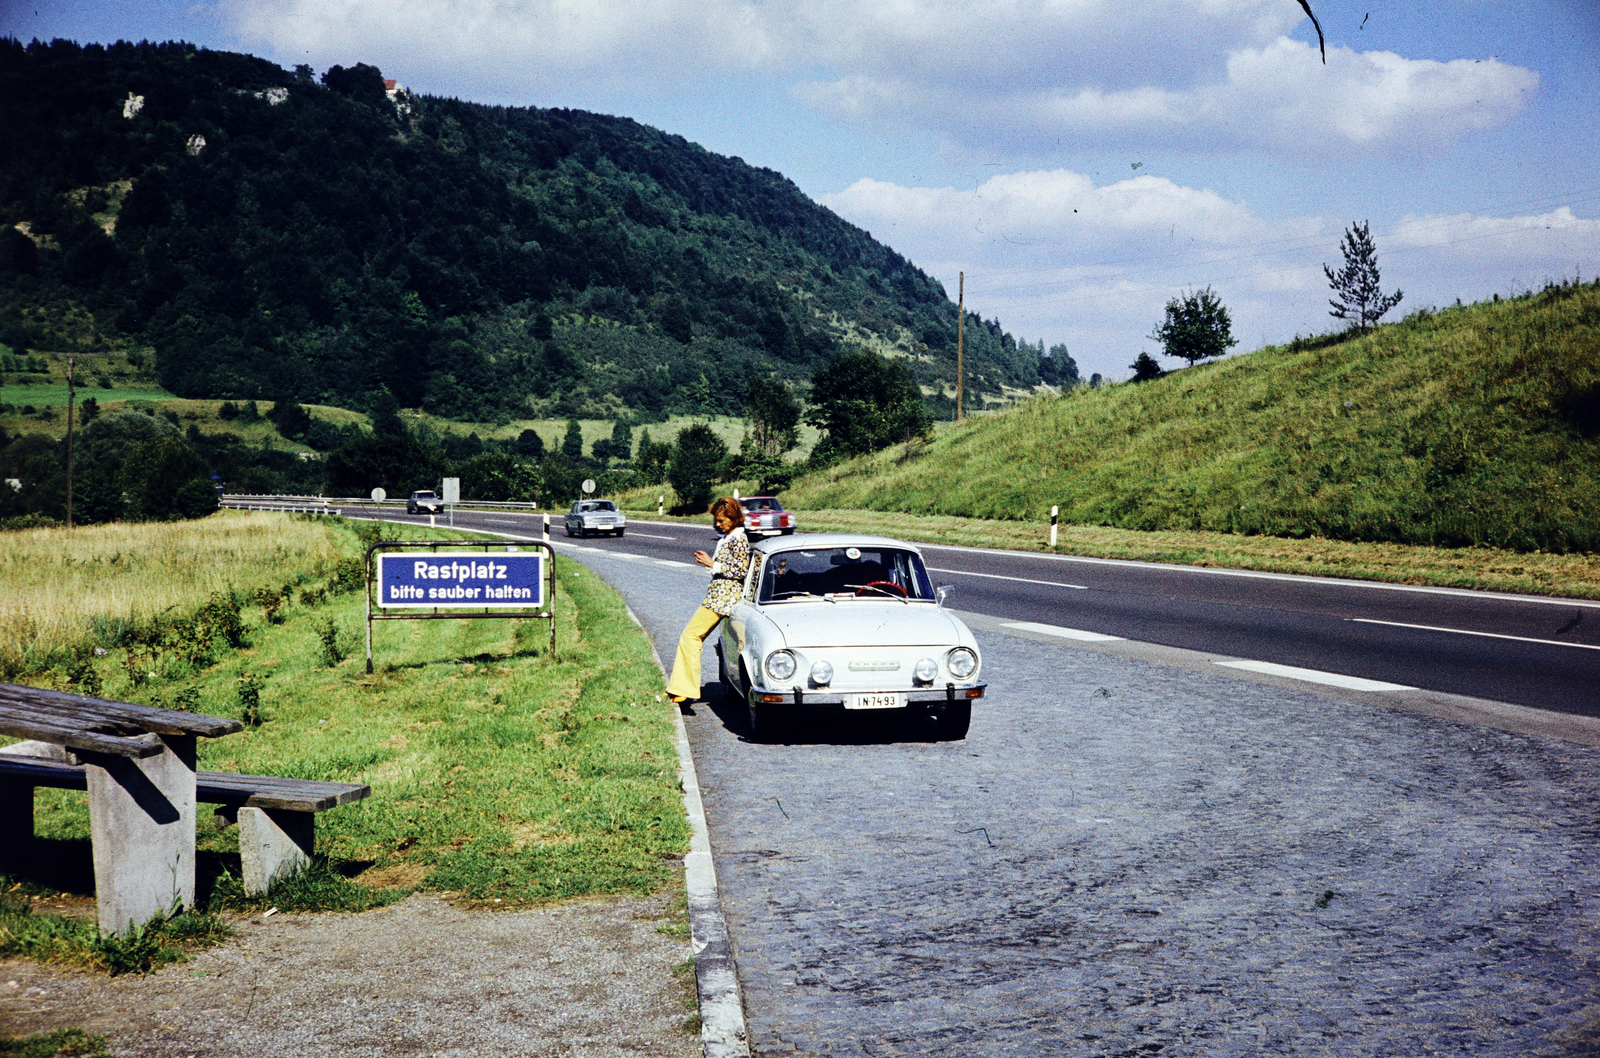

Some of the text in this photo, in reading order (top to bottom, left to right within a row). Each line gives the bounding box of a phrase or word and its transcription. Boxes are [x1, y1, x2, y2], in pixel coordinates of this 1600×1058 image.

[414, 561, 507, 582] Rastplatz
[390, 585, 531, 599] bitte sauber halten
